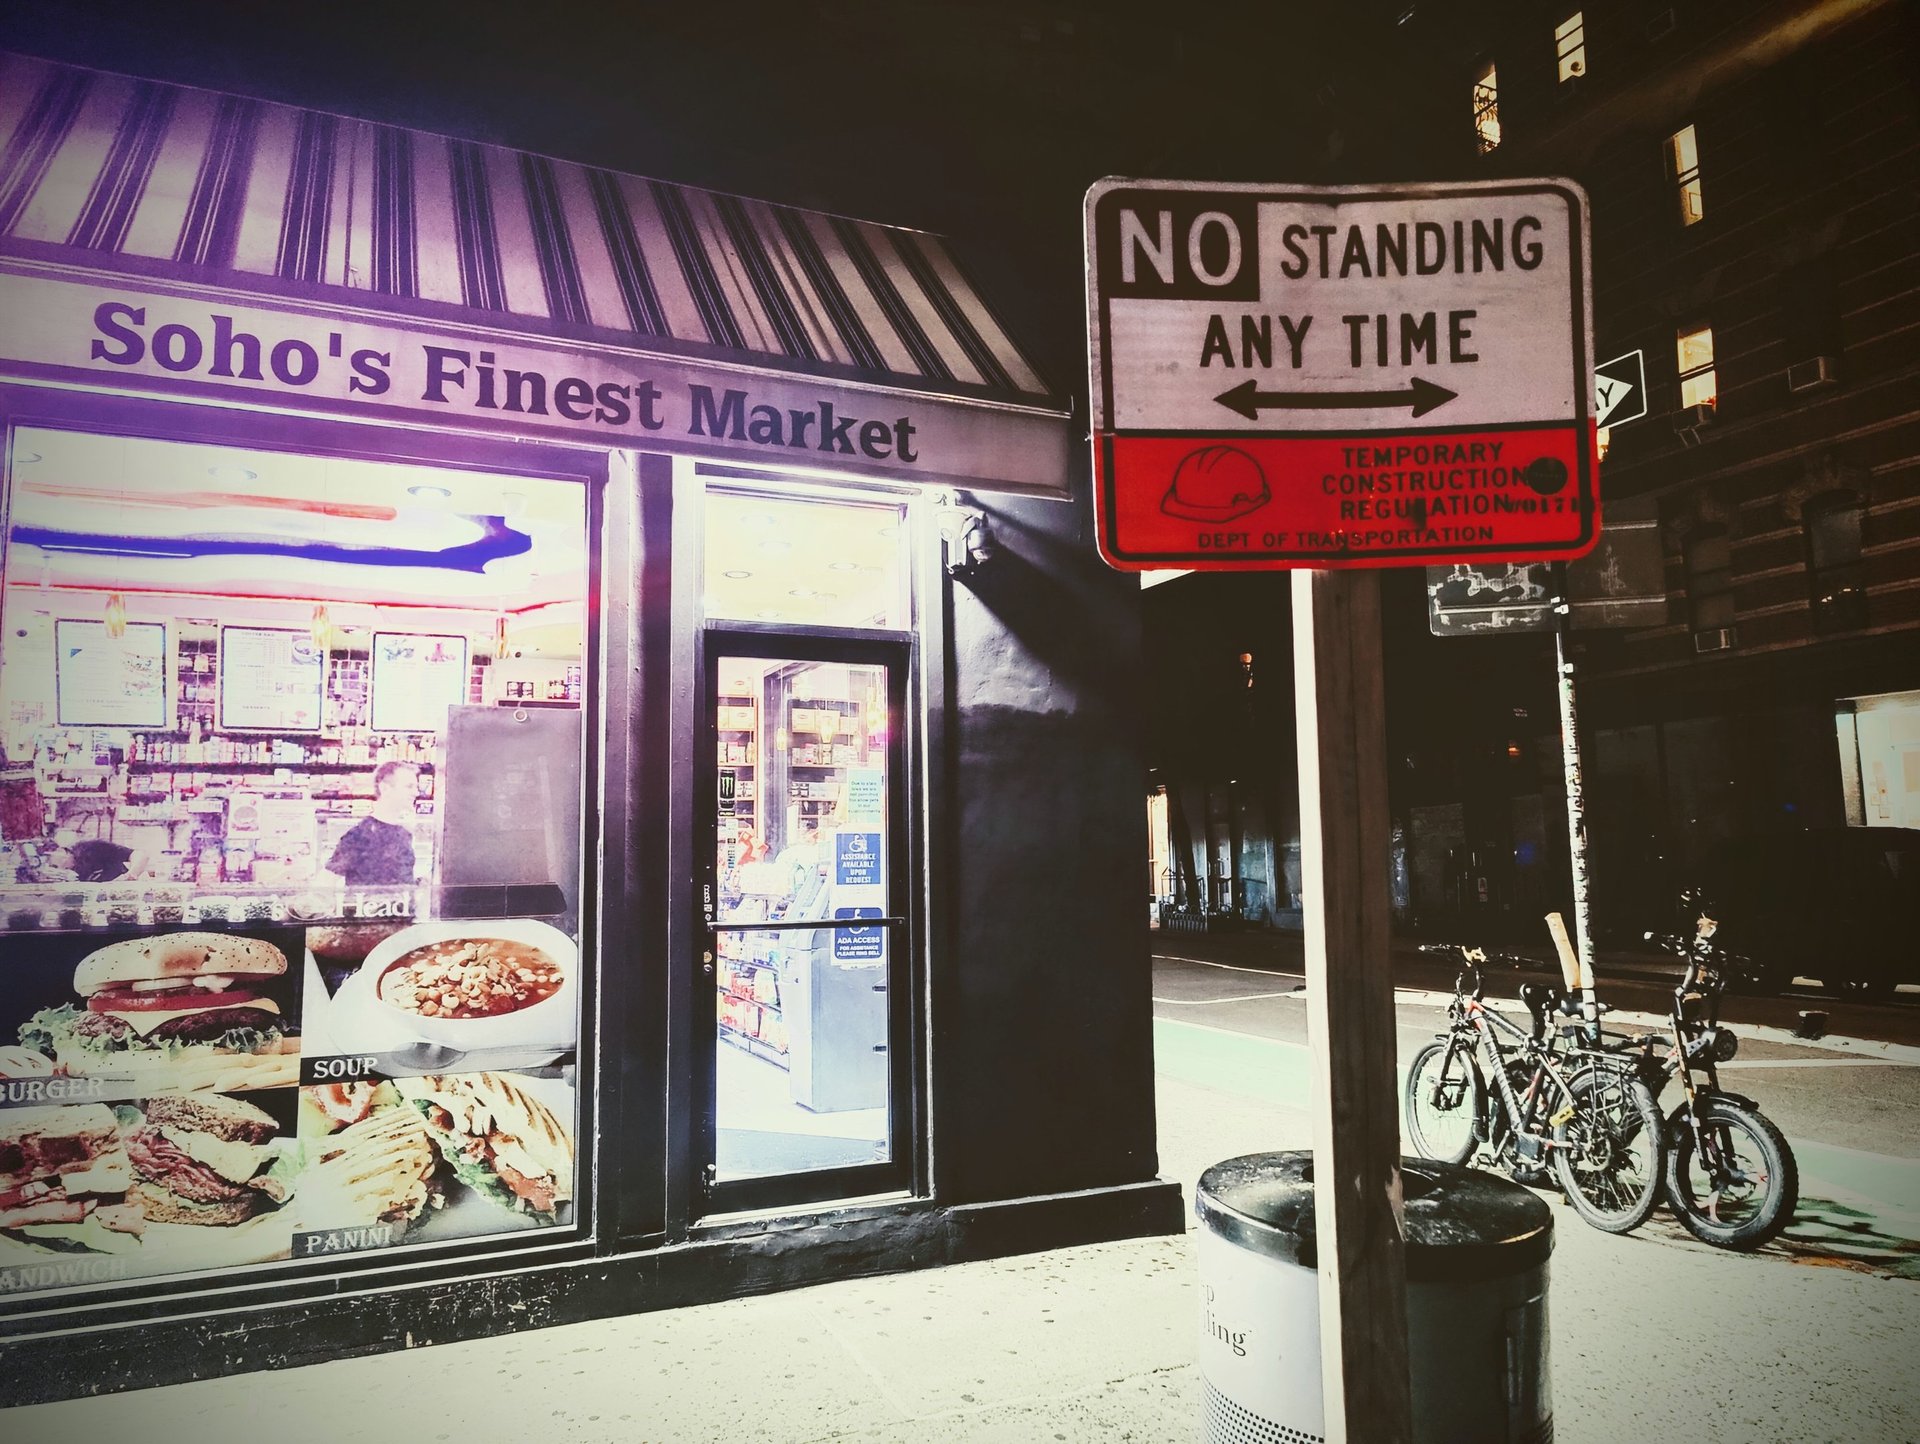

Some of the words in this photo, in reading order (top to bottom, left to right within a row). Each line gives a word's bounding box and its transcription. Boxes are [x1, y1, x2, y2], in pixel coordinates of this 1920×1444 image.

[1120, 209, 1242, 286] NO
[1280, 216, 1543, 279] STANDING
[1200, 315, 1313, 369] ANY
[1343, 310, 1480, 368] TIME
[91, 302, 391, 395] Soho's
[421, 345, 664, 430] Finest
[687, 384, 918, 463] Market
[1341, 442, 1503, 468] TEMPORARY
[1322, 467, 1531, 495] CONSTRUCTION
[1198, 532, 1249, 548] DEPT
[1263, 532, 1287, 547] OF
[1297, 526, 1493, 548] TRANSPORTATION
[313, 1057, 378, 1078] SOUP
[305, 1226, 393, 1254] PANINI
